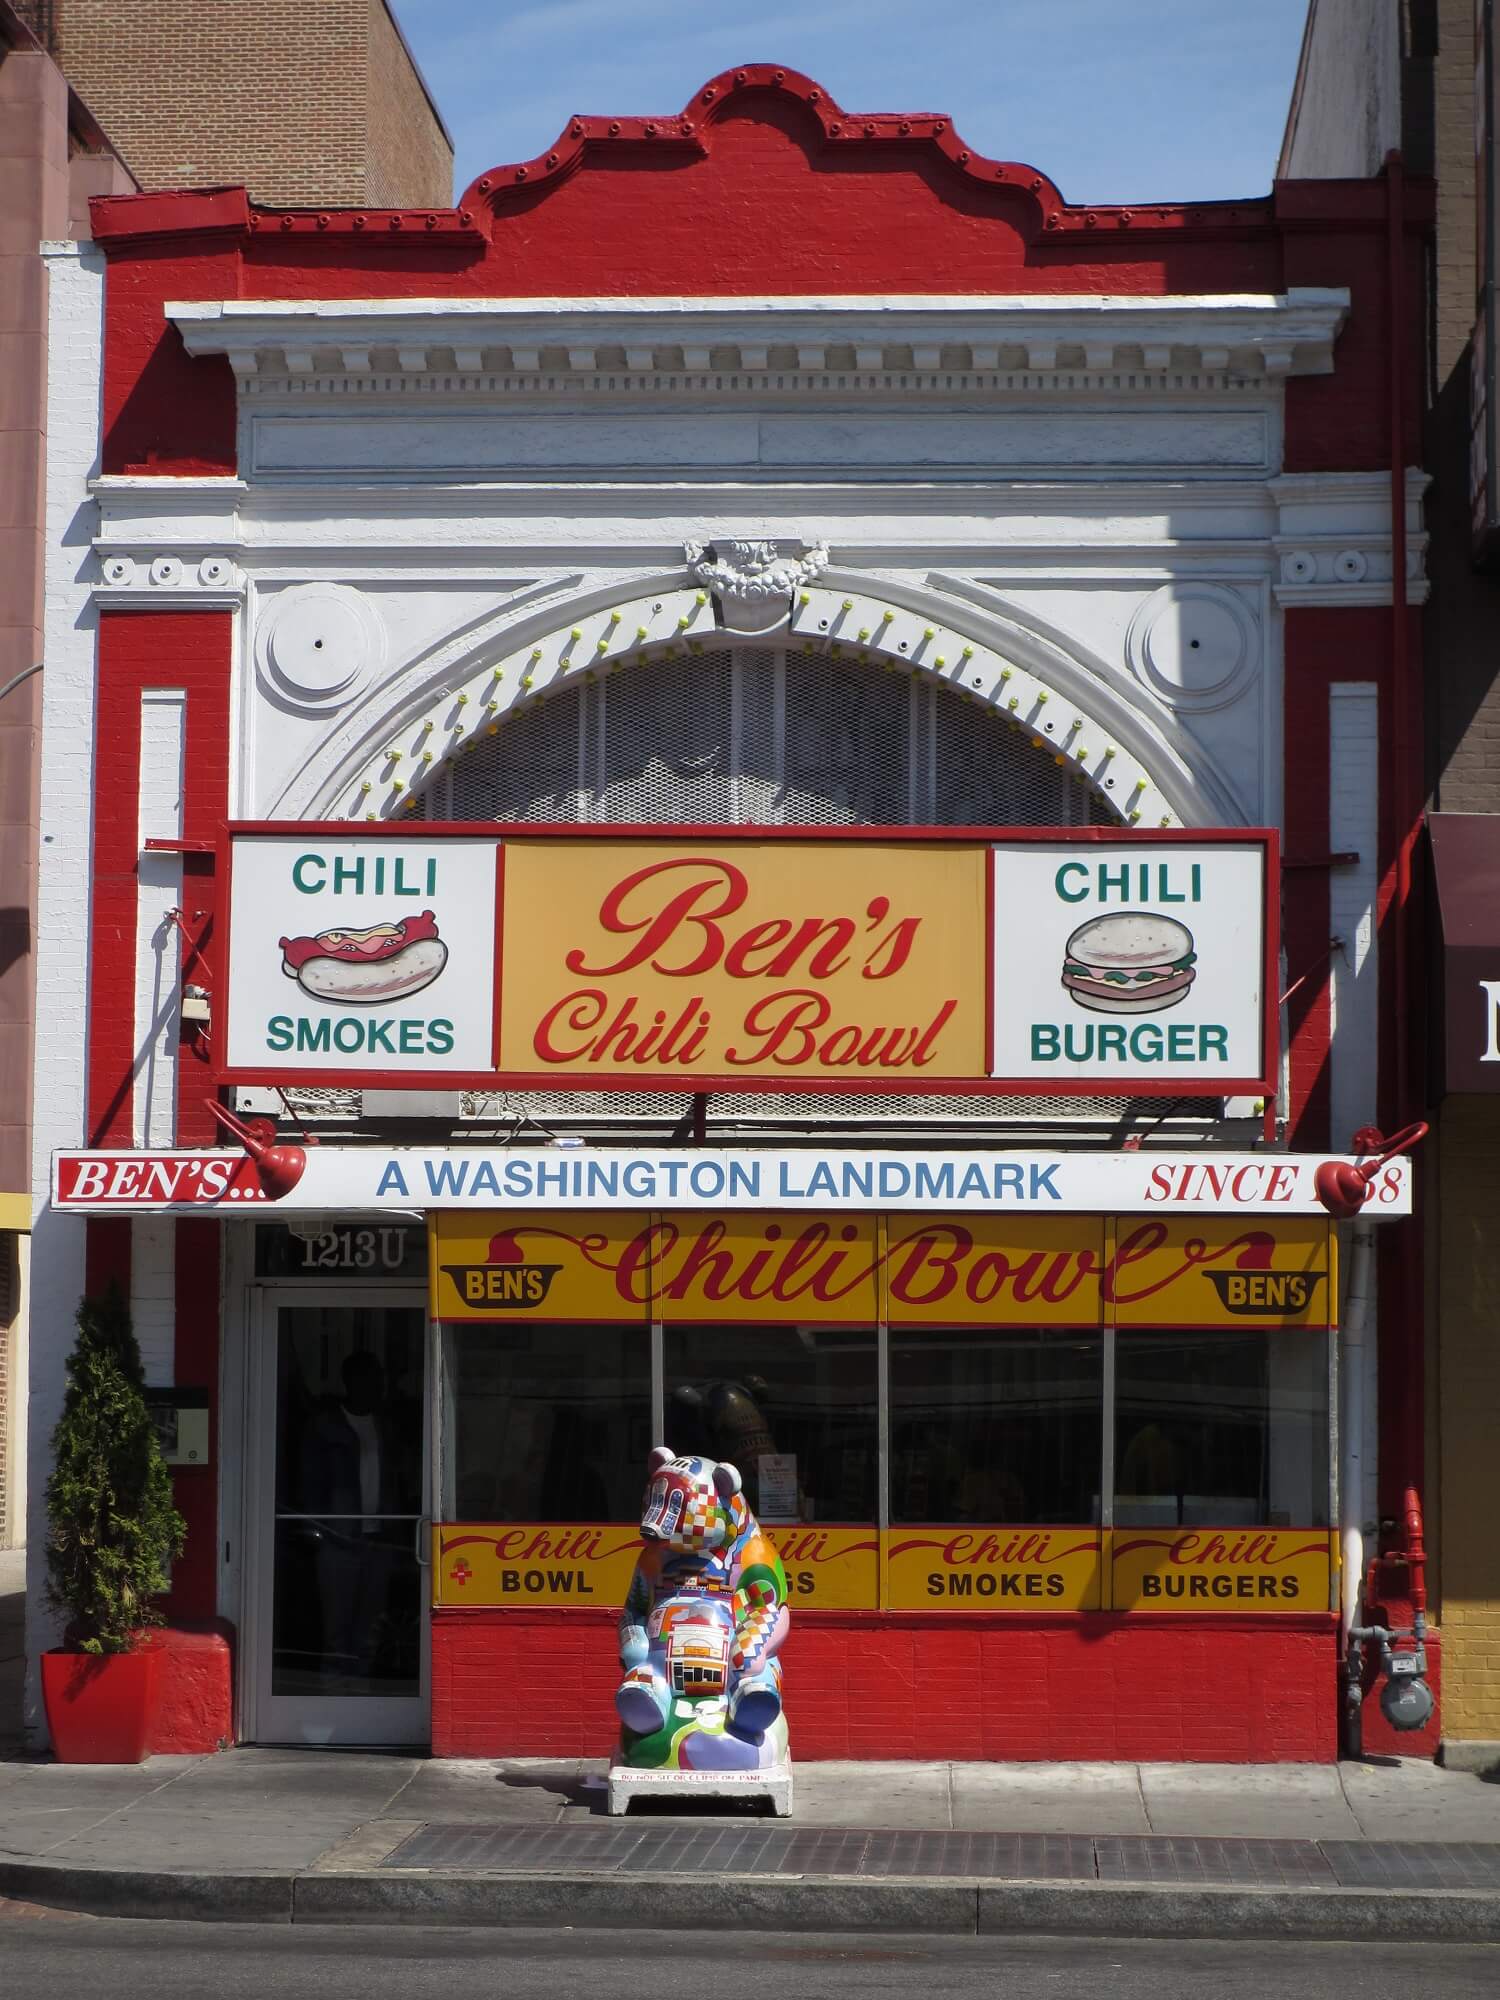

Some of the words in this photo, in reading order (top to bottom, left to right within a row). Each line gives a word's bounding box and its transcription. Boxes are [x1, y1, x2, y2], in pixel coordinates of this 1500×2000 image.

[292, 854, 437, 897] CHILI
[1055, 862, 1203, 903] CHILI
[565, 857, 923, 979] Ben's
[266, 1015, 455, 1055] SMOKES
[533, 988, 711, 1064] Chili
[724, 988, 958, 1067] Bowl
[1031, 1023, 1229, 1063] BURGER
[375, 1160, 410, 1197] A
[423, 1160, 761, 1199] WASHINGTON
[779, 1161, 1063, 1200] LANDMARK
[1143, 1163, 1300, 1203] SINCE
[612, 1220, 862, 1303] Chili
[888, 1222, 1180, 1304] Bowl
[466, 1268, 544, 1301] BEN'S
[1228, 1273, 1307, 1306] BEN'S
[495, 1530, 604, 1561] Chili
[942, 1533, 1055, 1564] Chili
[1168, 1534, 1283, 1565] Chili
[502, 1569, 594, 1594] BOWL
[926, 1573, 1066, 1597] SMOKES
[1142, 1575, 1300, 1599] BURGERS
